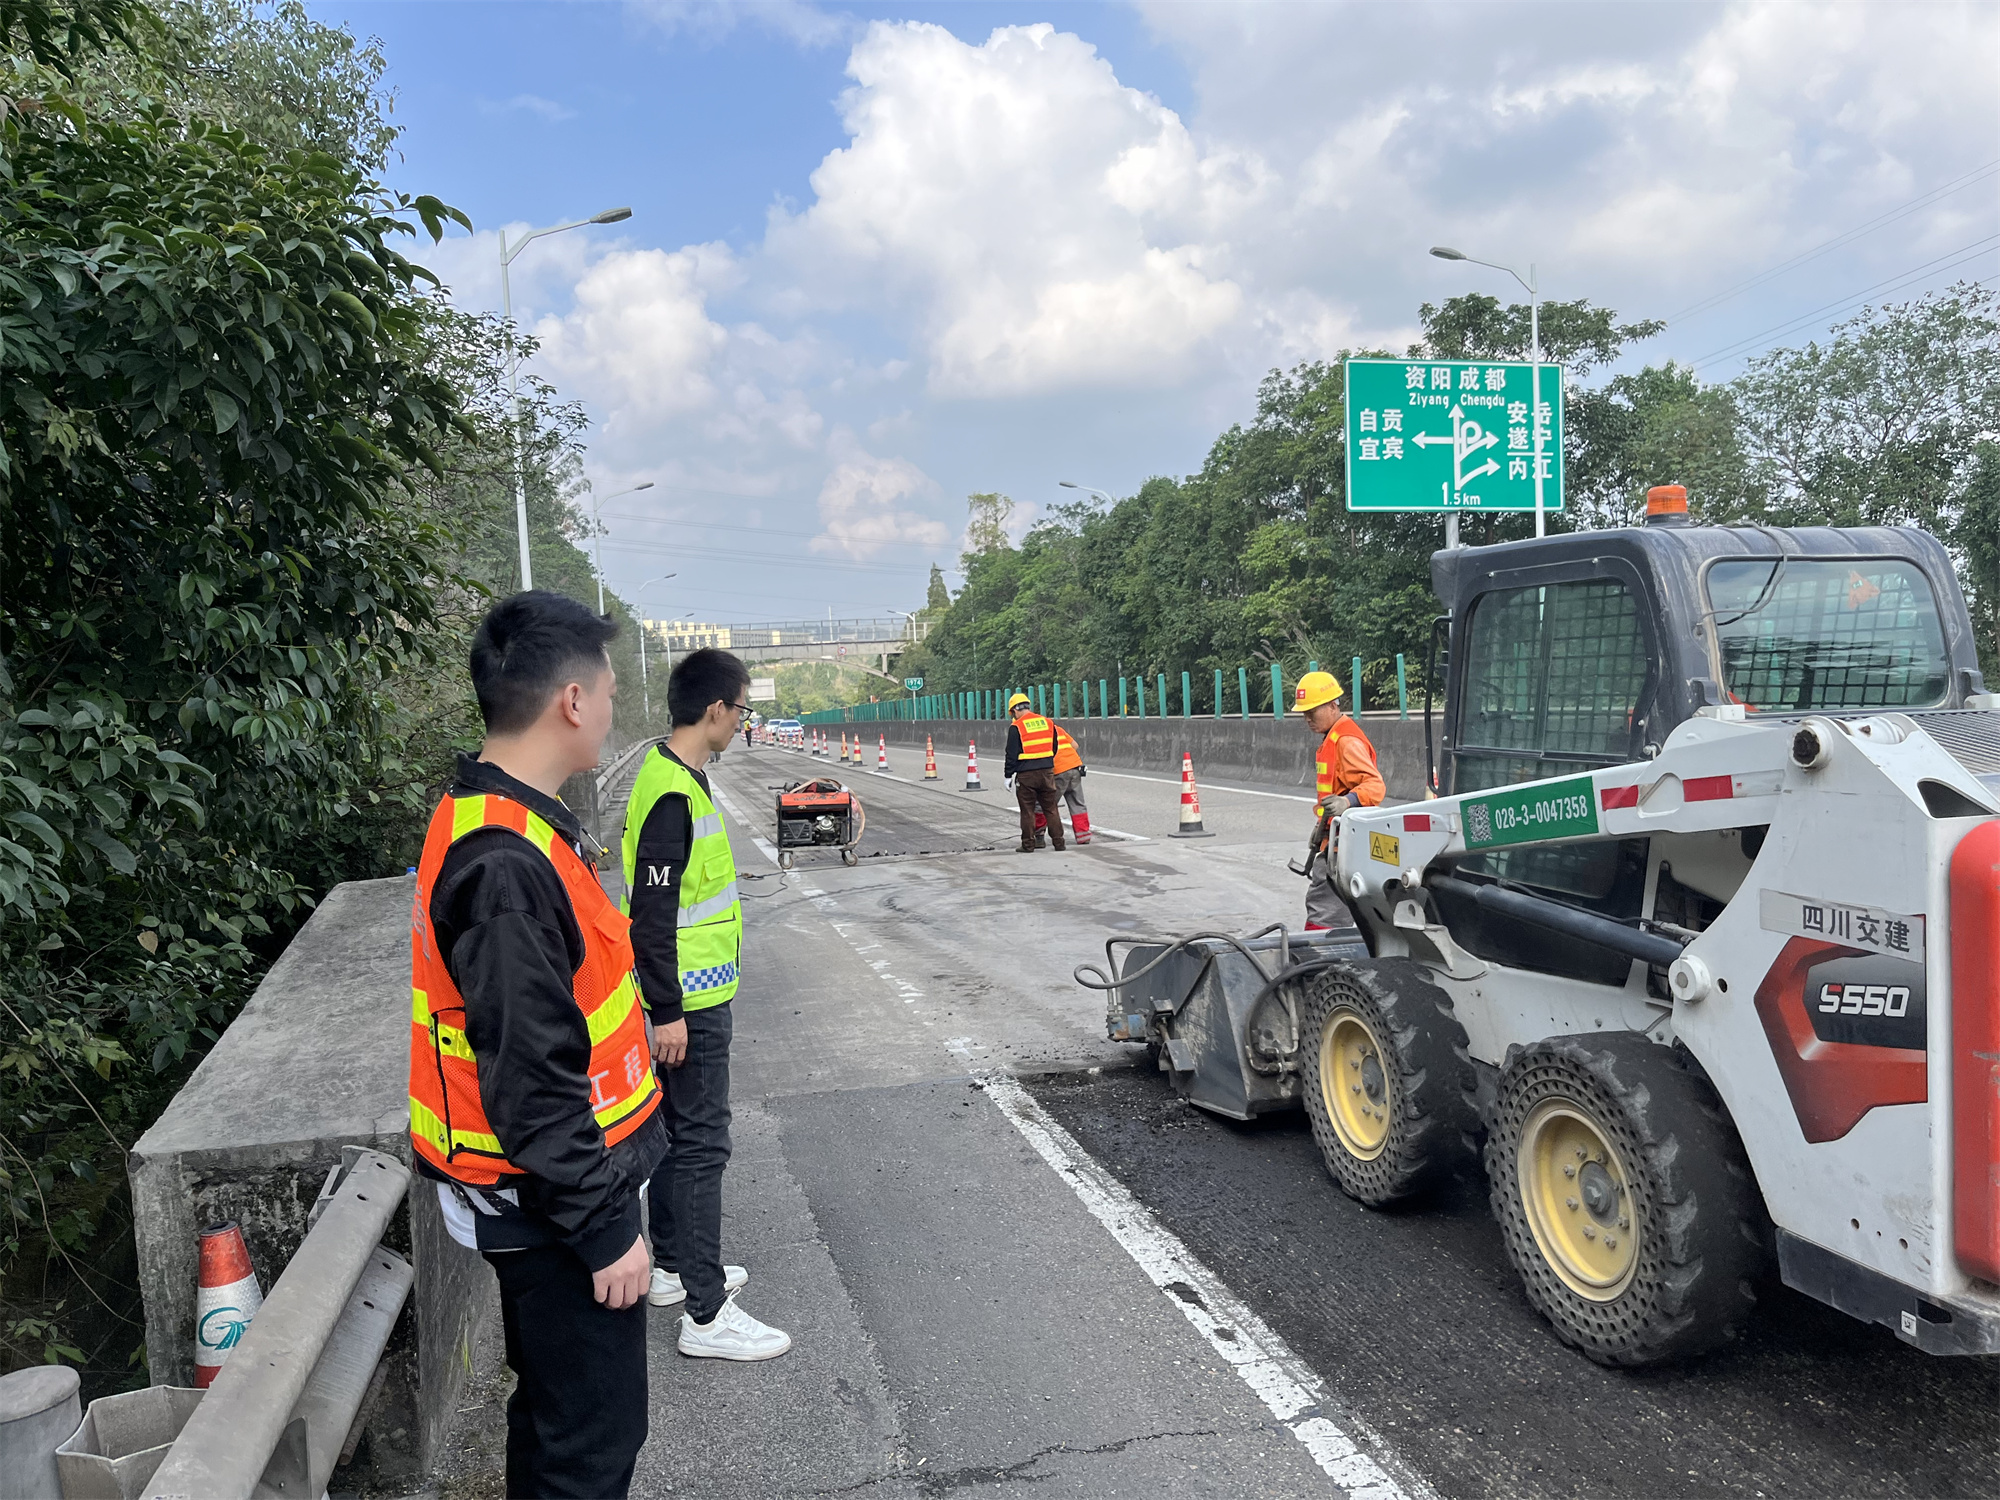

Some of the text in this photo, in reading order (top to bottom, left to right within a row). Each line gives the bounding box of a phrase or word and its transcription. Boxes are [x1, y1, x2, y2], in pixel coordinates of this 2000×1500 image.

[1409, 393, 1505, 410] Ziyang Chengdu
[1507, 401, 1553, 425] 安岳
[1359, 408, 1404, 432] 自贡
[1358, 437, 1404, 461] 宜宾
[1507, 427, 1553, 450] 遂宁
[1508, 457, 1553, 480] 内江
[1495, 795, 1588, 830] 028-3-0047358
[646, 865, 671, 886] M
[1802, 904, 1910, 953] 四川交建
[1818, 984, 1910, 1018] S550
[591, 1045, 643, 1111] 工程
